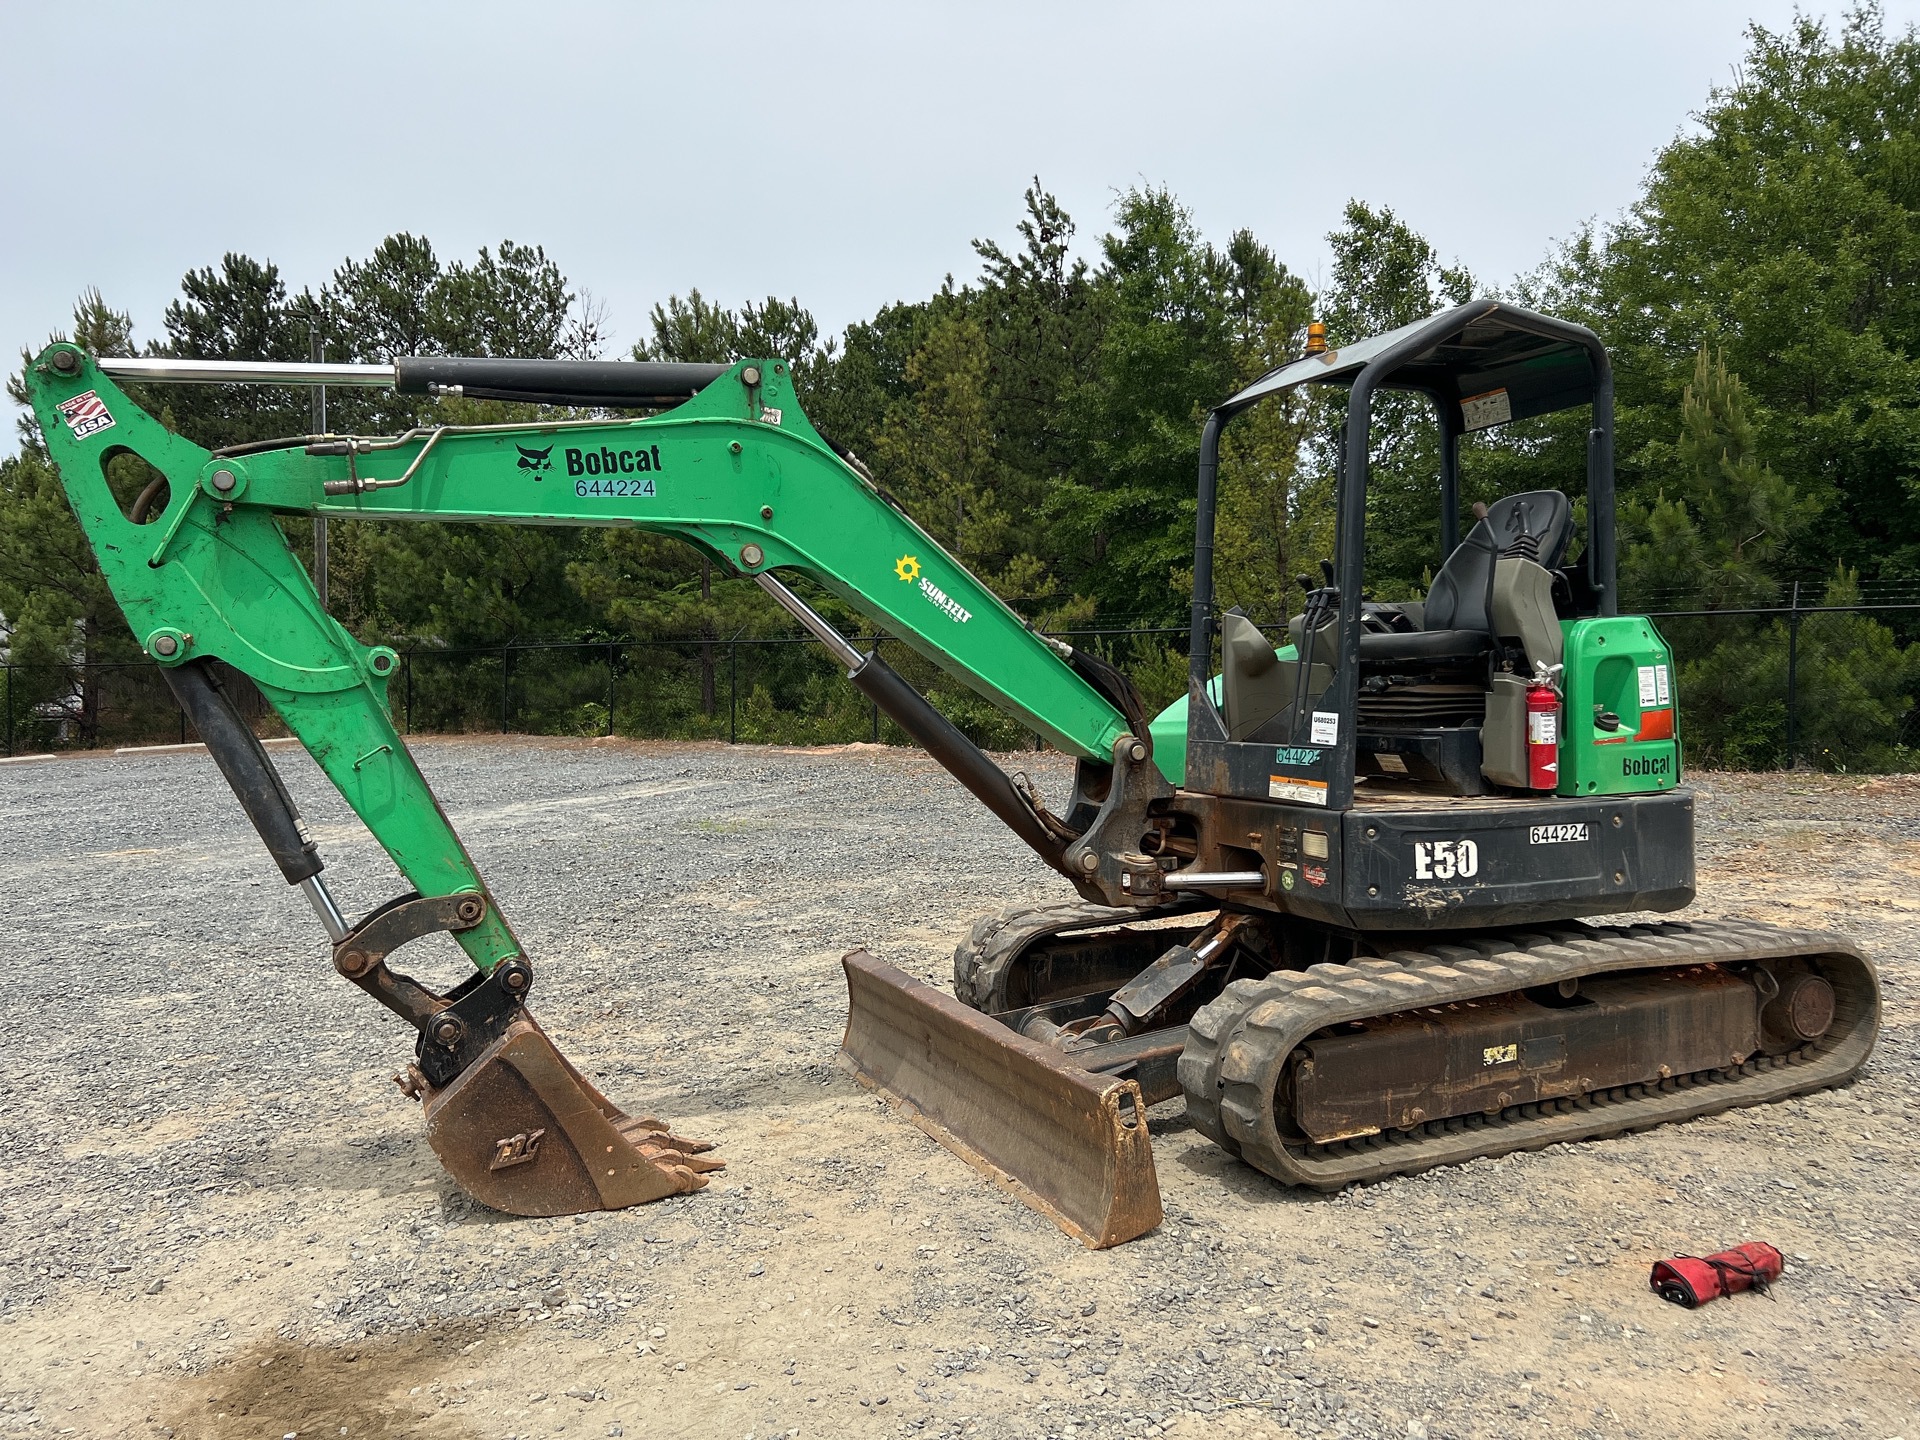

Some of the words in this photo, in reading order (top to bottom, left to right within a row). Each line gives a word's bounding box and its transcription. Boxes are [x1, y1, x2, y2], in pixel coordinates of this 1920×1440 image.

[74, 415, 111, 436] USA
[565, 445, 662, 476] Bobcat
[575, 480, 655, 497] 644224
[918, 577, 973, 623] SUNBELT
[1623, 754, 1670, 776] Bobcat
[1531, 825, 1588, 843] 644224
[1415, 840, 1478, 880] E50
